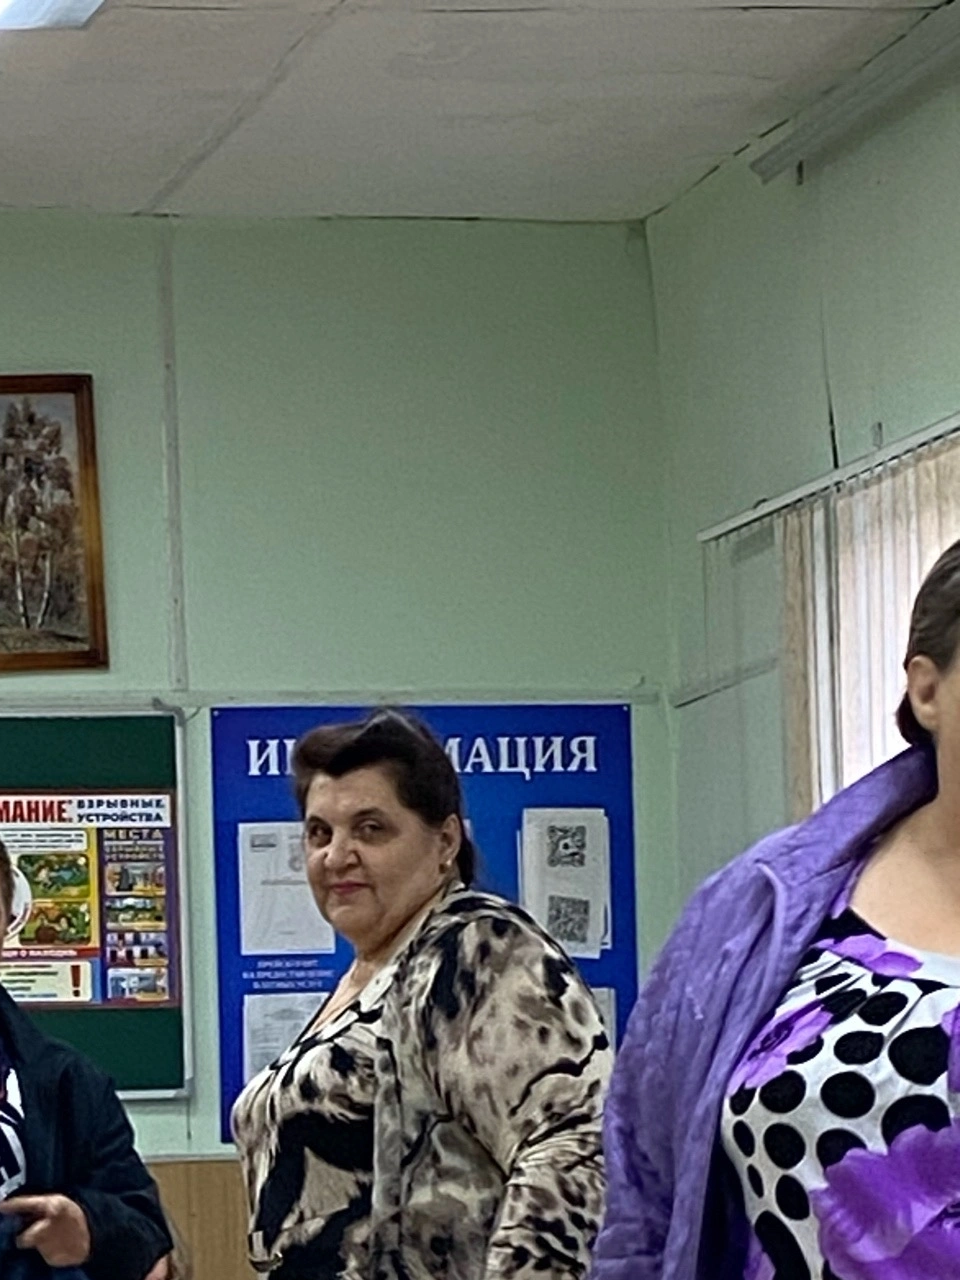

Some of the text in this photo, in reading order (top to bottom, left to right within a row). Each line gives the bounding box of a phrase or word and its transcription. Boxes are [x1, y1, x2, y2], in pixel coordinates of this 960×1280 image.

[246, 736, 597, 780] ИМАЦИЯ
[77, 799, 165, 809] ВЗРЫВНЫЕ
[77, 810, 164, 823] УСТРОЙСТВА
[103, 828, 164, 840] МЕСТА
